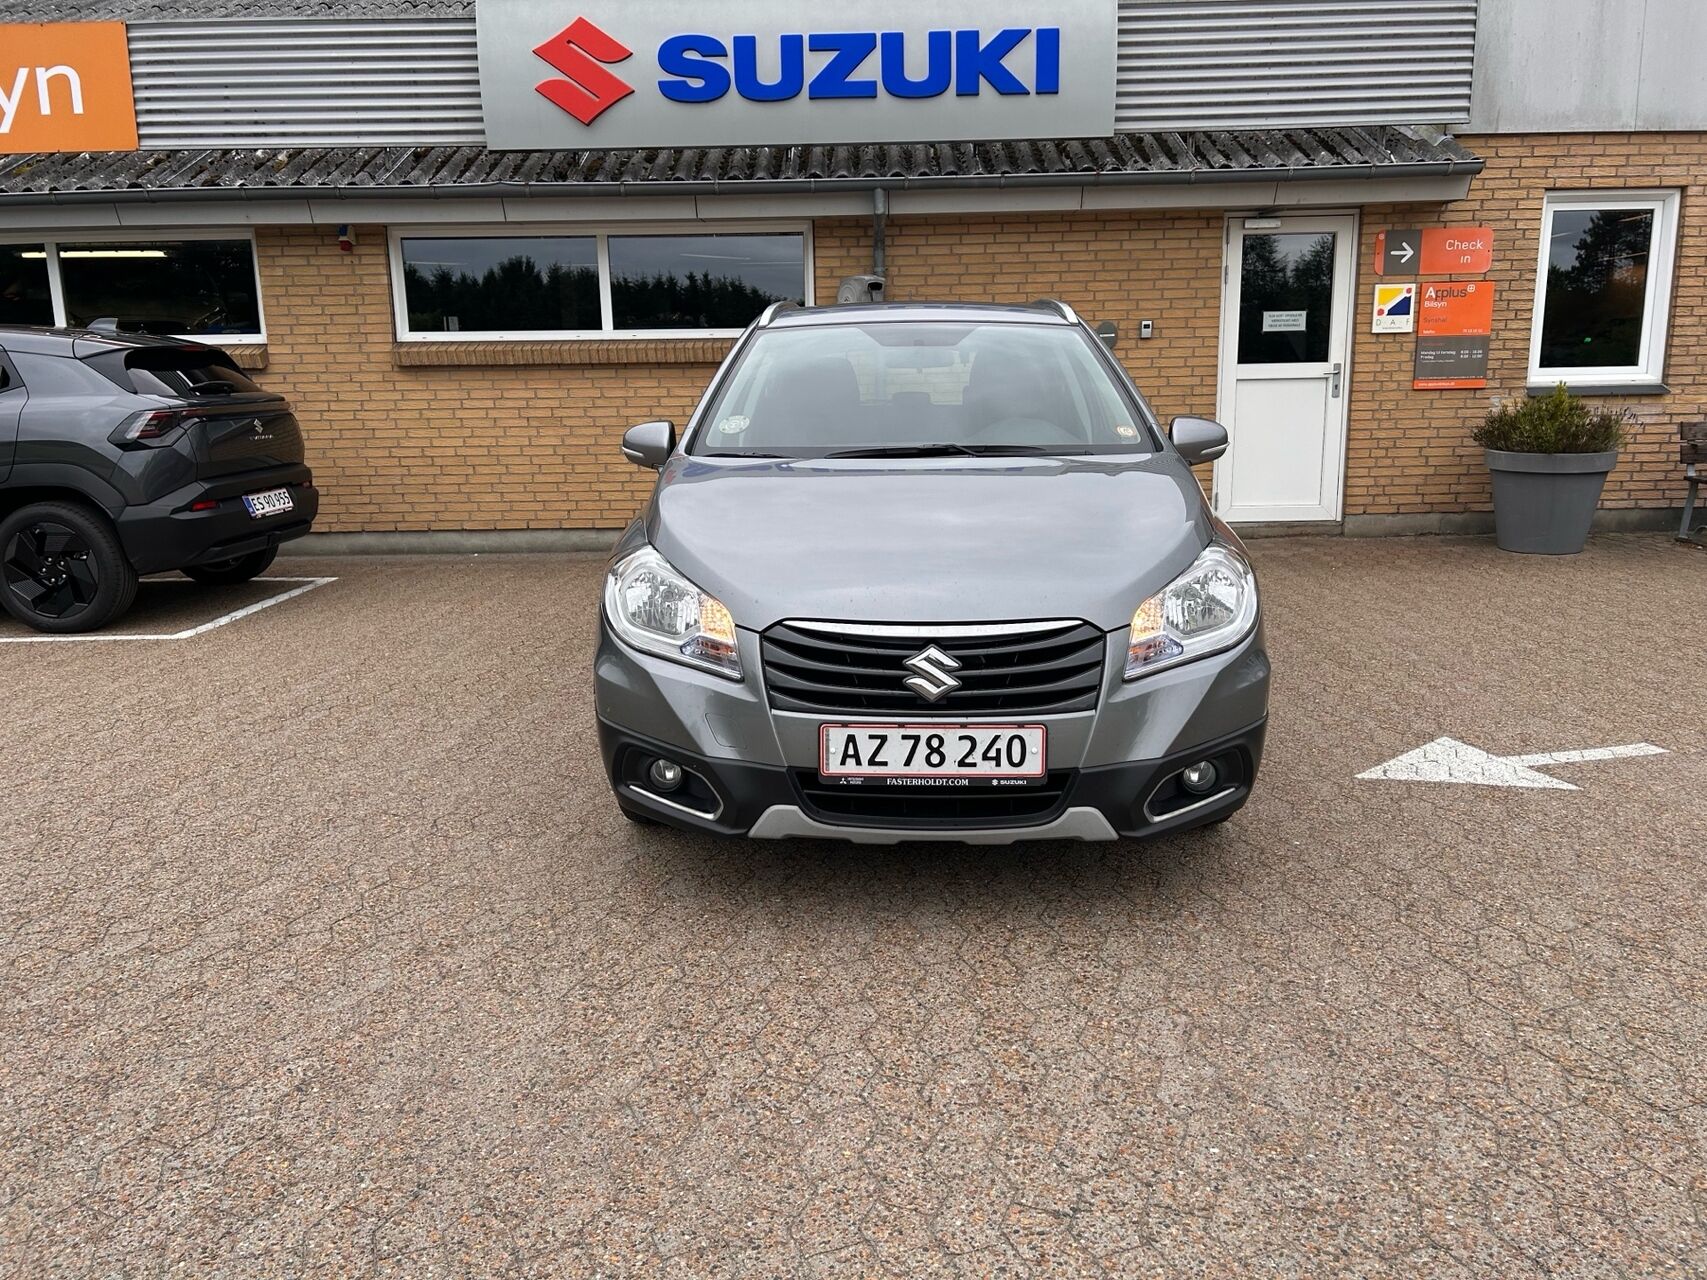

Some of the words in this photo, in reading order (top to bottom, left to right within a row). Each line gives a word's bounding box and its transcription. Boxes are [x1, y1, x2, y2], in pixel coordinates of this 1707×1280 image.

[657, 27, 1061, 103] SUZUKI
[1445, 239, 1483, 250] Check
[1460, 255, 1471, 264] in
[1424, 300, 1447, 308] Bilsyn
[250, 496, 265, 512] ES
[263, 494, 276, 508] 90
[274, 491, 291, 506] 955
[839, 733, 889, 767] AZ
[901, 733, 947, 768] 78
[956, 734, 1027, 768] 240
[886, 778, 969, 786] FASTERHOLDT.COM
